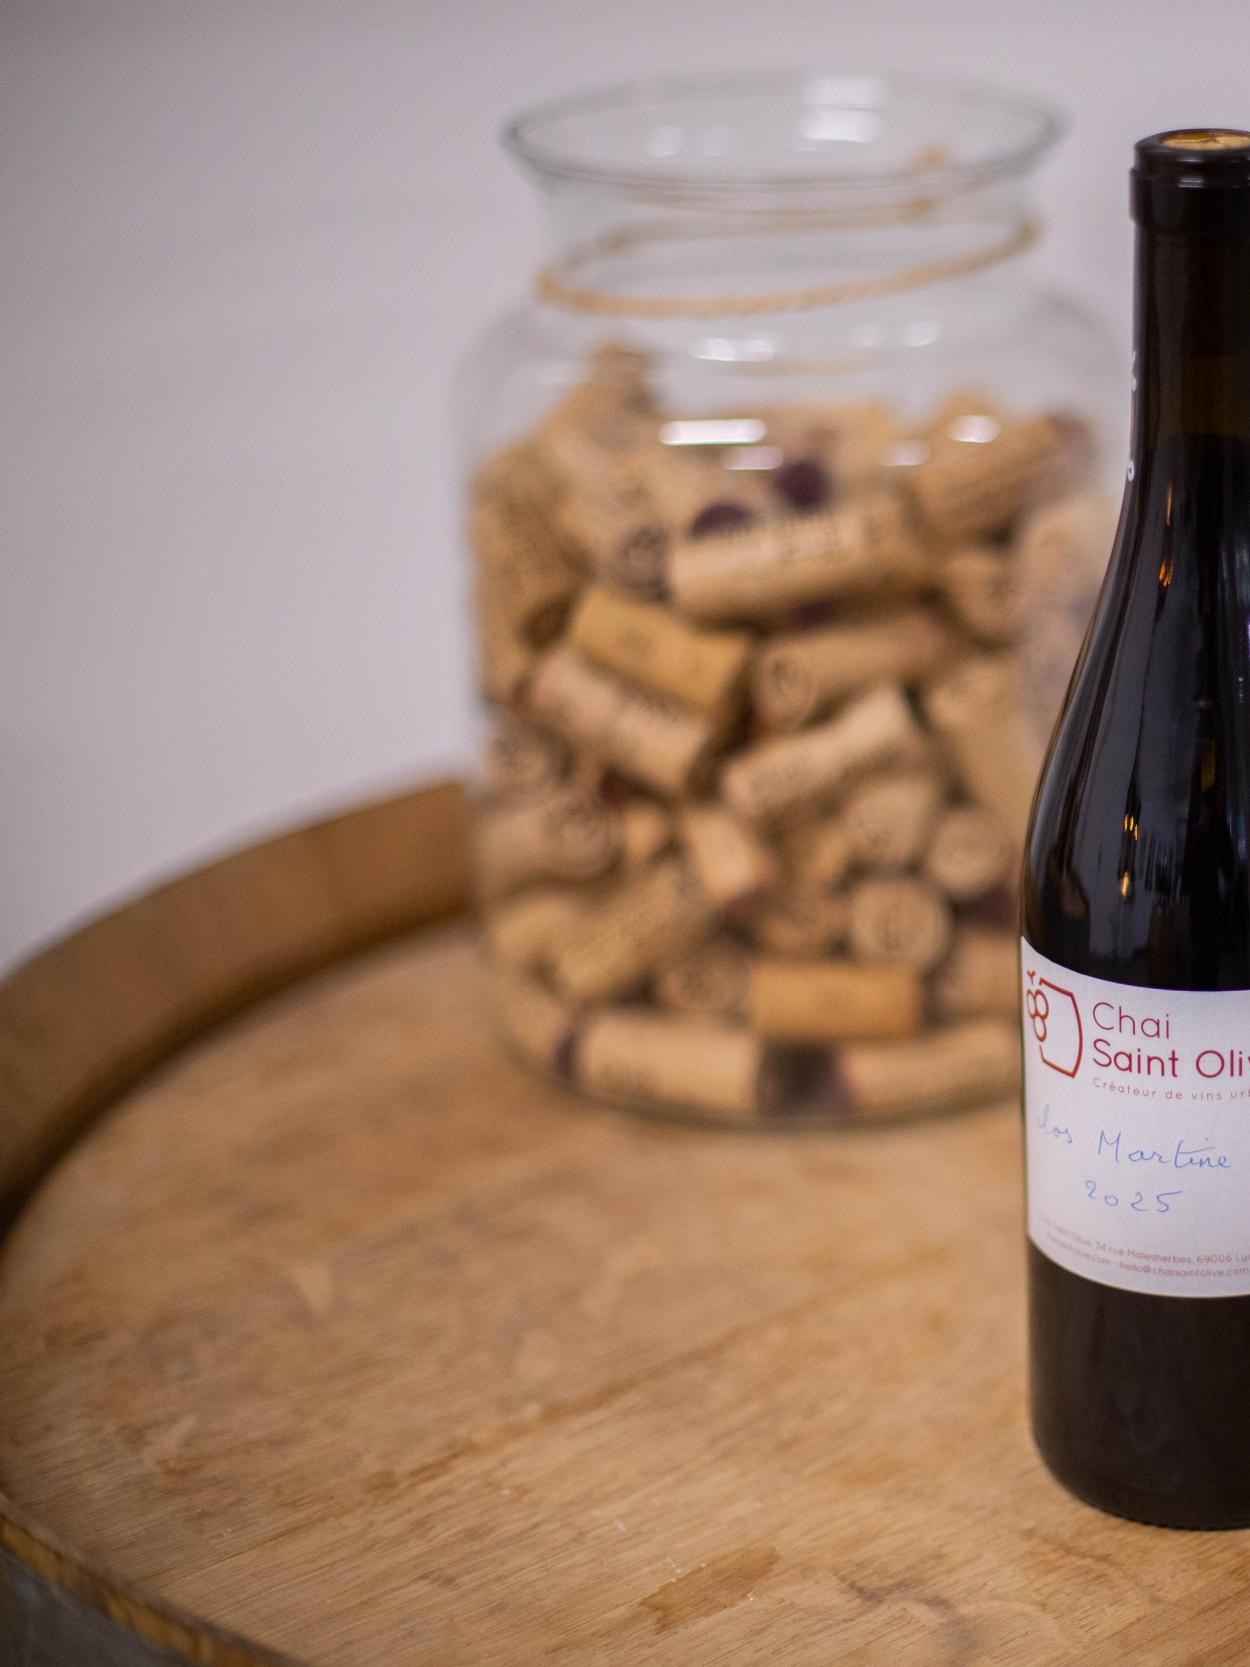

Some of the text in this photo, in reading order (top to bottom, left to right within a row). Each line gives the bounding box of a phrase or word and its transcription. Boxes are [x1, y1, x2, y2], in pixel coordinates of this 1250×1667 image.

[1092, 1001, 1171, 1039] Chai
[1092, 1038, 1179, 1078] Saint
[1092, 1077, 1157, 1099] Créateur
[1165, 1089, 1183, 1100] de
[1191, 1088, 1223, 1101] vins
[1097, 1129, 1232, 1169] Martine
[1083, 1177, 1183, 1213] 2025
[1108, 1245, 1125, 1256] rue
[1196, 1253, 1232, 1264] 69006
